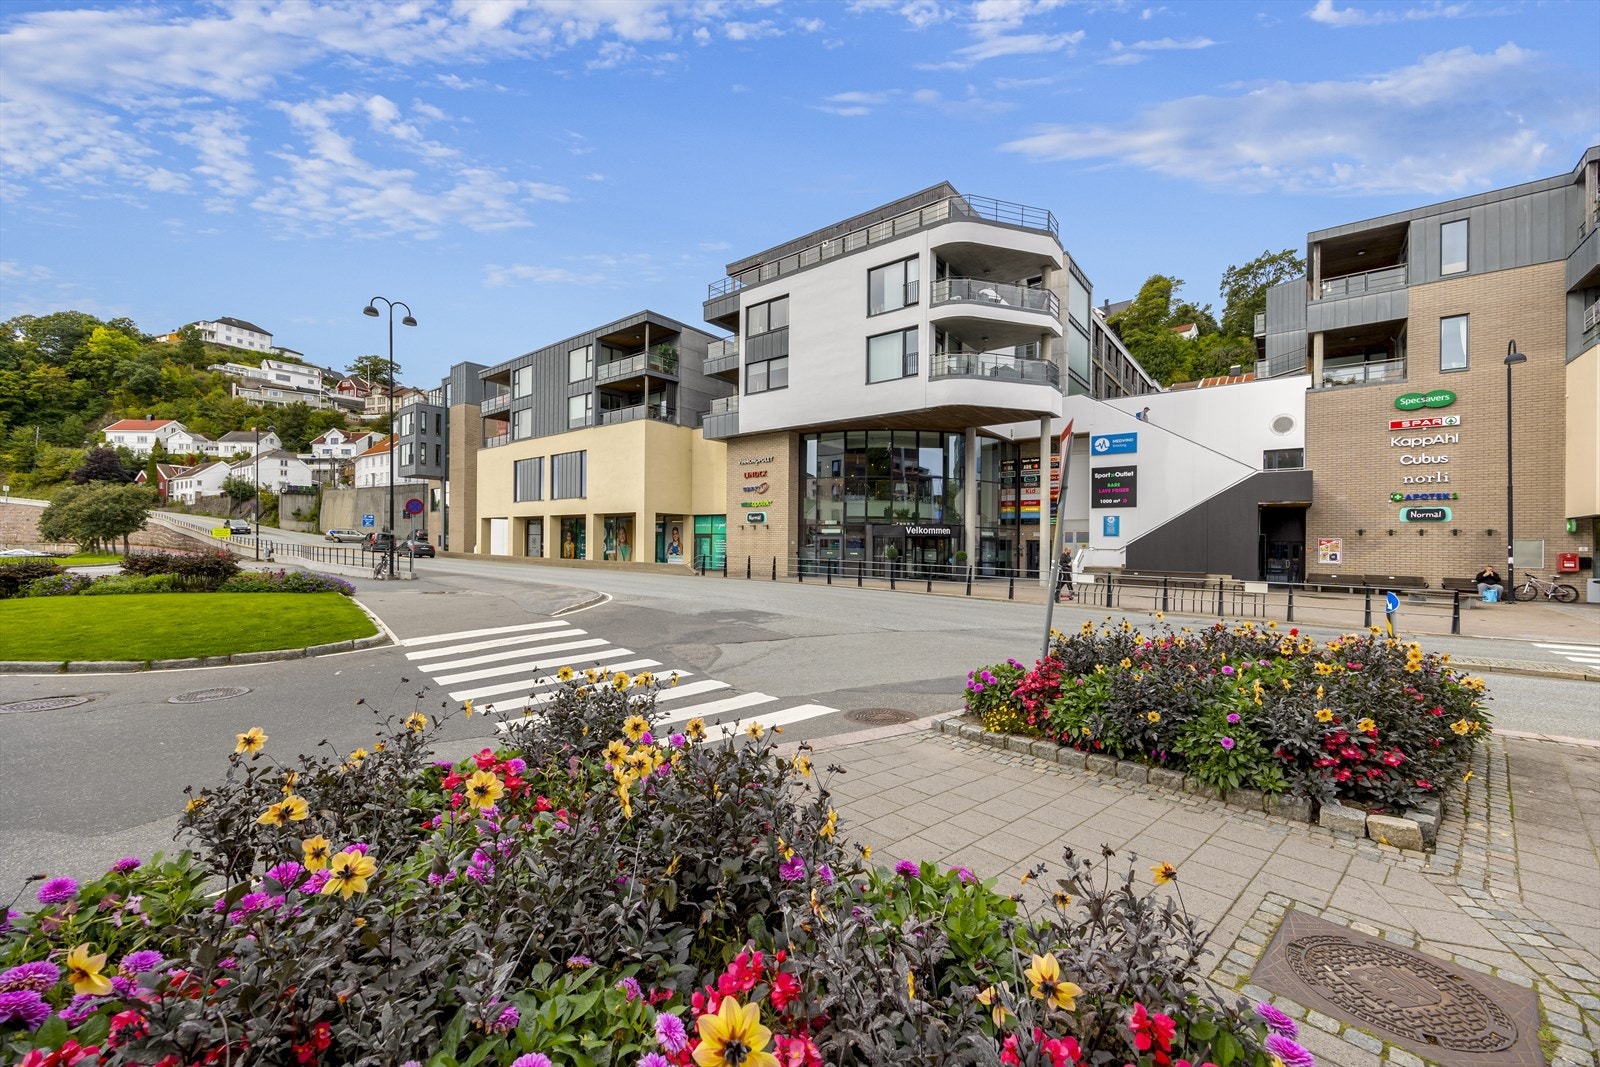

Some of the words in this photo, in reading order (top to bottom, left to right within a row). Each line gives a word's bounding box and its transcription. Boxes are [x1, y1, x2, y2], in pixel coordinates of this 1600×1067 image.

[1400, 394, 1450, 405] Specsavers
[1402, 418, 1442, 428] SPAR
[1390, 433, 1459, 448] KappAhl
[1400, 453, 1449, 465] Cubus
[1403, 472, 1449, 484] norli
[1452, 492, 1458, 500] 1
[1410, 510, 1442, 518] Normal
[905, 526, 951, 535] Velkommen
